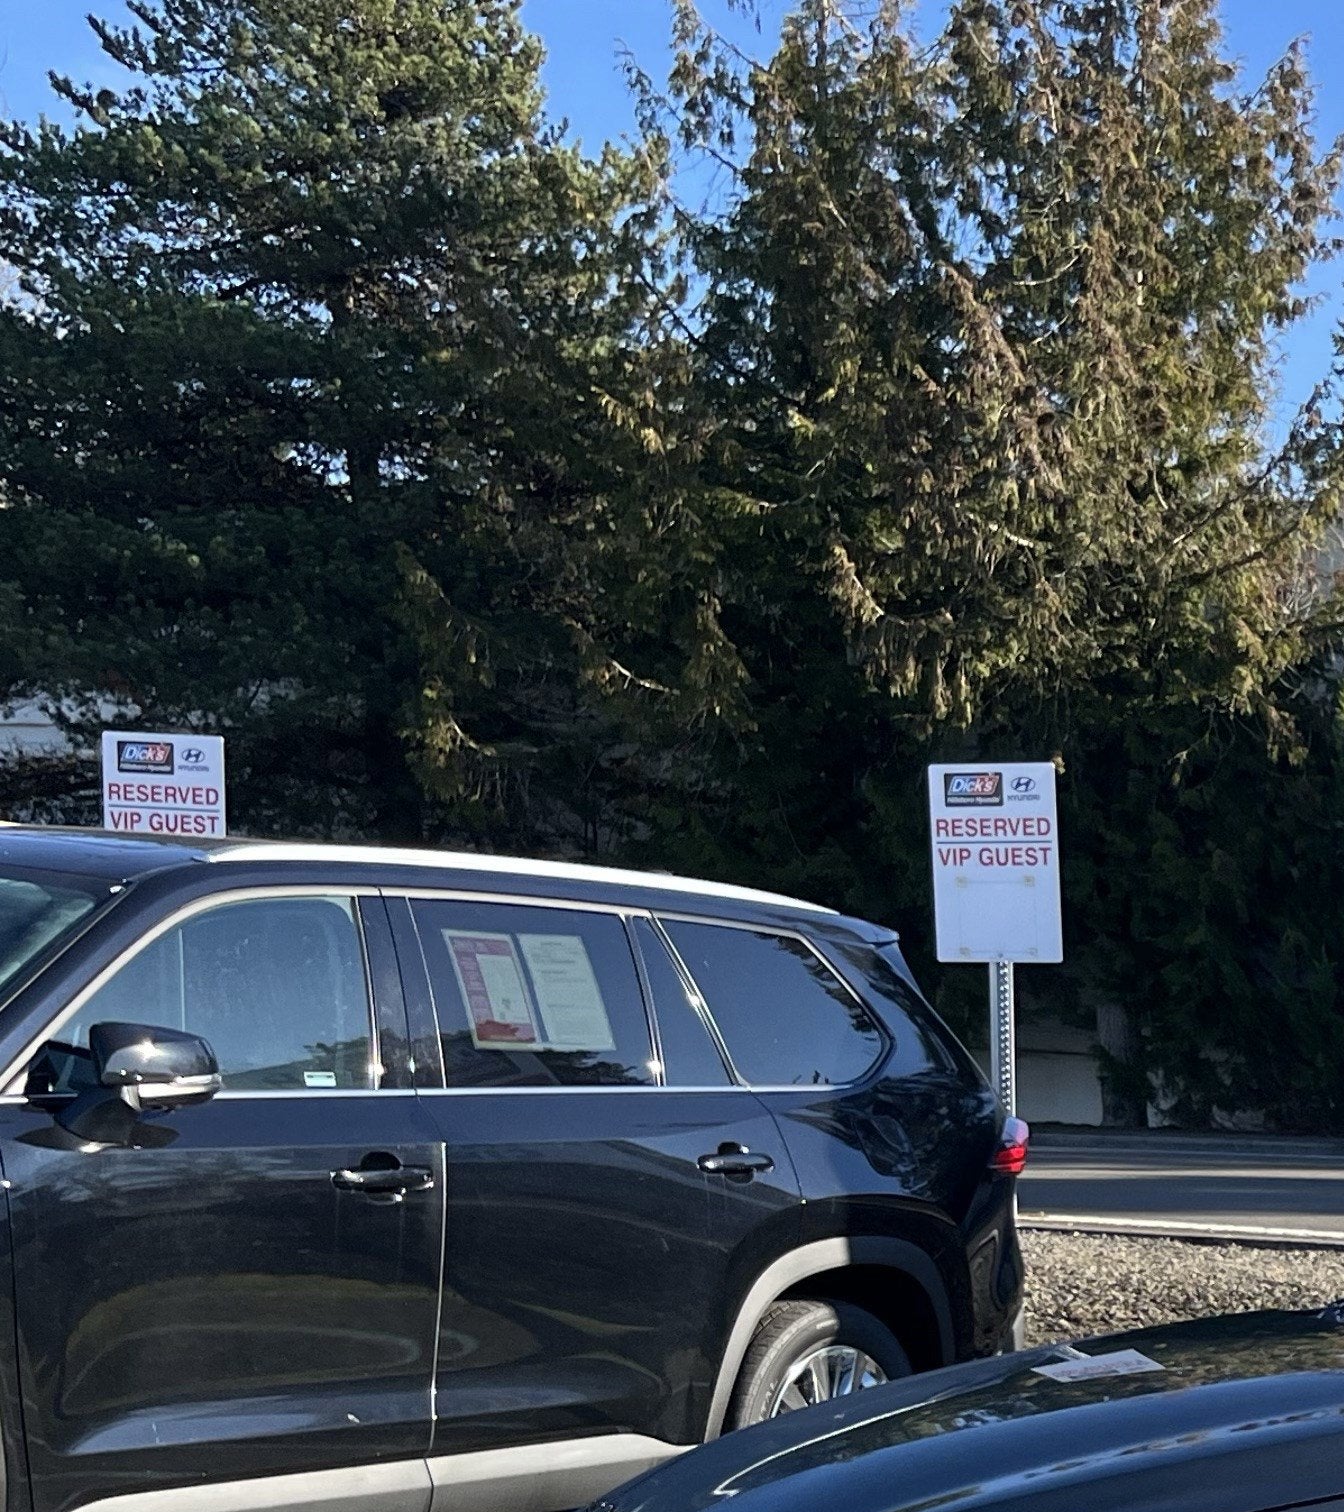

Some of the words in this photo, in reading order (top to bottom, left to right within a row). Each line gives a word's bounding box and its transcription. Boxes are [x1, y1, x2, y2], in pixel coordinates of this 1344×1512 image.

[108, 783, 219, 805] RESERVED
[110, 811, 142, 830] VIP
[149, 813, 220, 834] GUEST
[936, 817, 1051, 838] RESERVED
[937, 848, 971, 866] VIP
[979, 847, 1051, 866] GUEST
